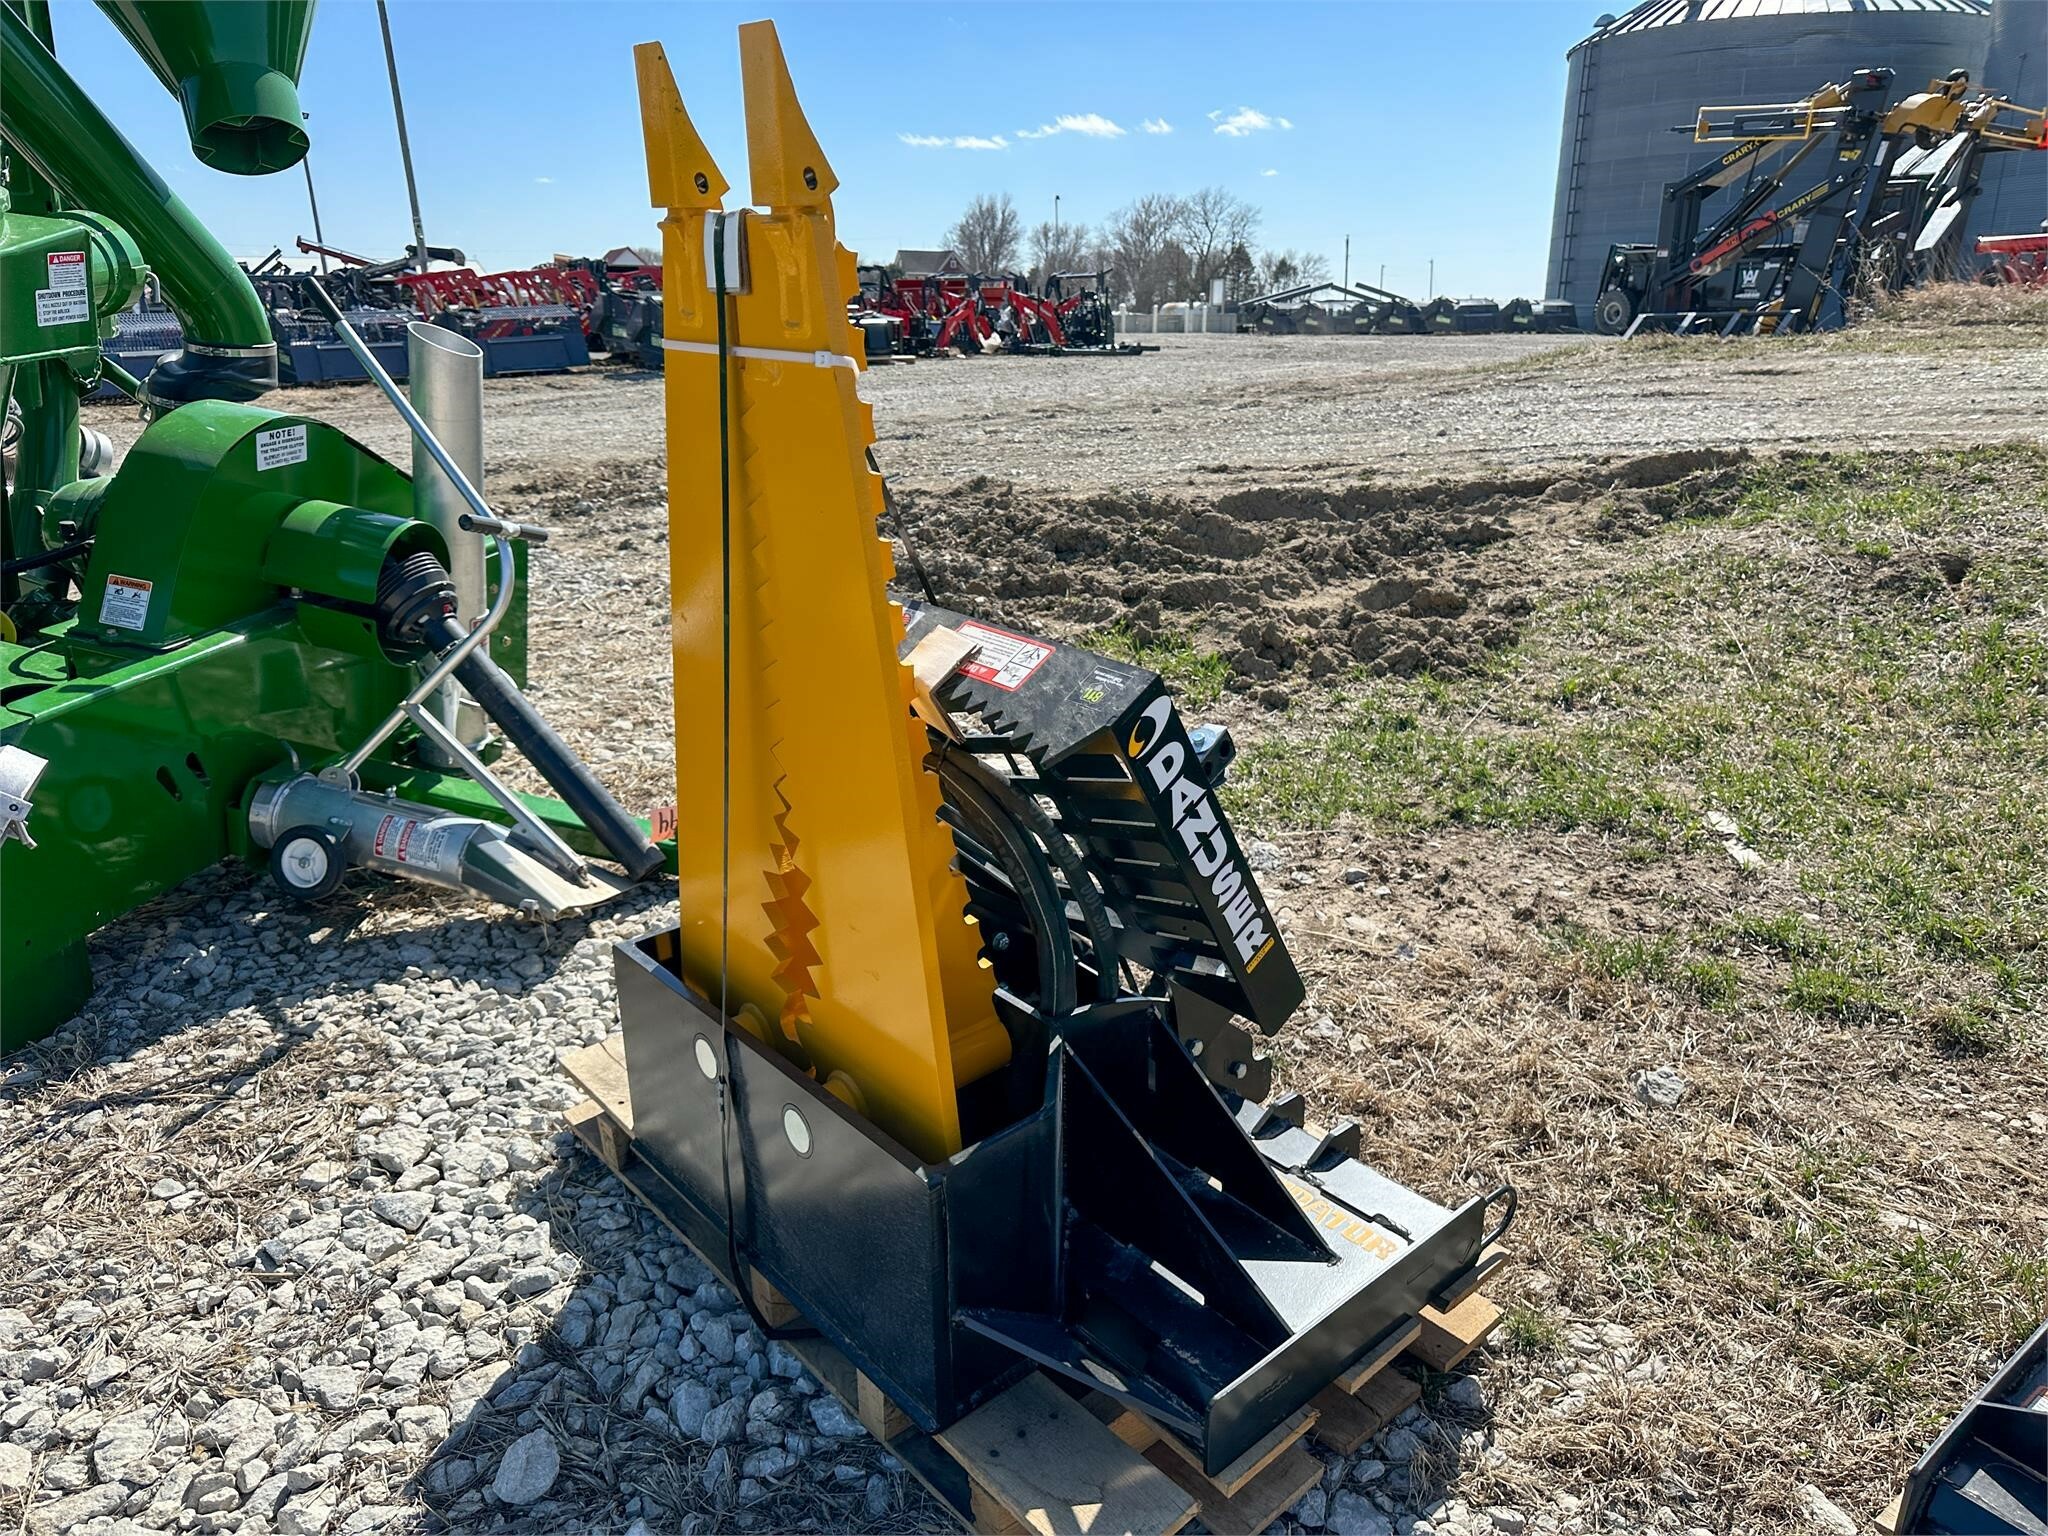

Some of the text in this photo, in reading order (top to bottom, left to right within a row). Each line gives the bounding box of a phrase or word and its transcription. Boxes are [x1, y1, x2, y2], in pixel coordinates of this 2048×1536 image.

[1776, 193, 1813, 219] CRARY
[59, 254, 81, 263] DANGER
[37, 289, 86, 300] SHUTDOWN PROCEDURE
[269, 428, 296, 440] NOTE!
[269, 445, 289, 454] TRACTOR
[119, 580, 147, 589] WARNING
[1082, 688, 1105, 704] 811
[377, 816, 393, 845] DANGER
[400, 822, 415, 850] DANGER
[1146, 740, 1272, 964] DANUSER
